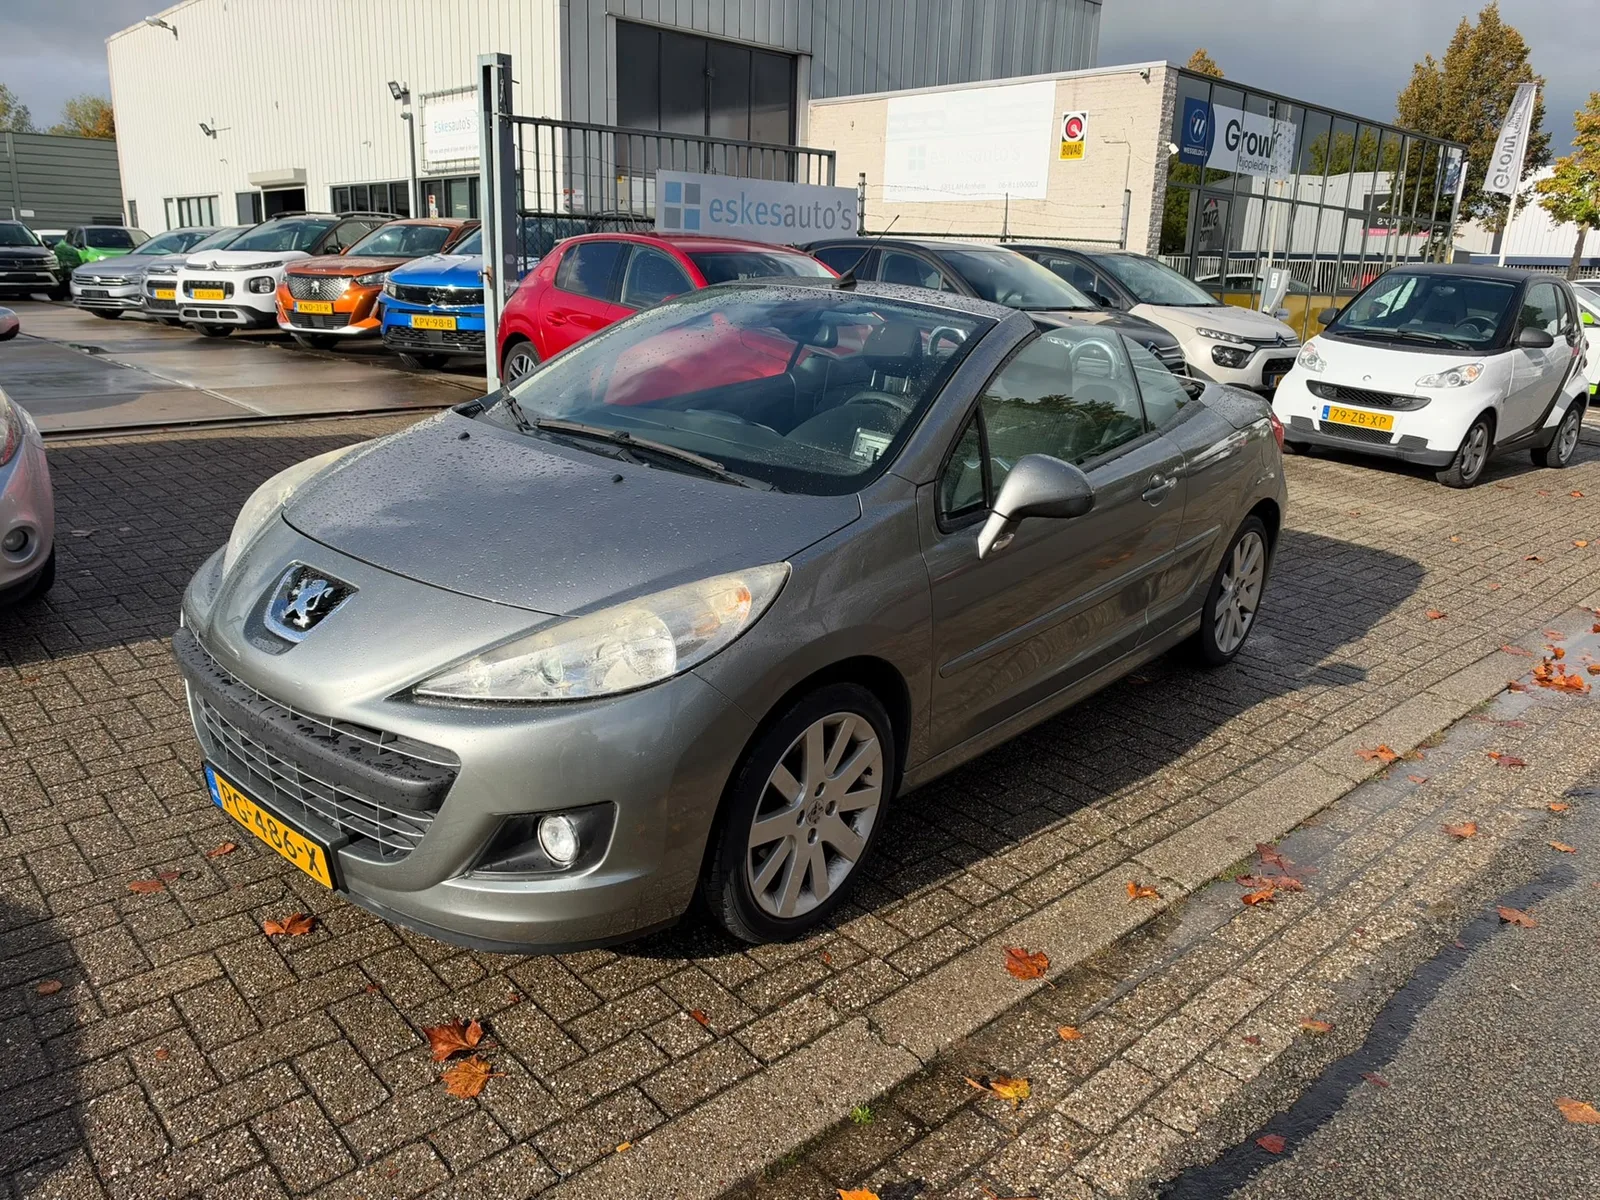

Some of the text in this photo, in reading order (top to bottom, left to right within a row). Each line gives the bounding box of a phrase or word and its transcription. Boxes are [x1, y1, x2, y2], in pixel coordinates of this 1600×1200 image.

[434, 117, 471, 134] Eskesauto's
[1226, 119, 1275, 159] Grow
[1062, 143, 1082, 156] BOVAG
[709, 191, 852, 231] eskesauto's
[299, 303, 329, 312] KND-31-R
[414, 316, 453, 328] KPV-98-B
[1332, 408, 1387, 427] 79-ZB-XP
[220, 781, 322, 877] PG-486-X
